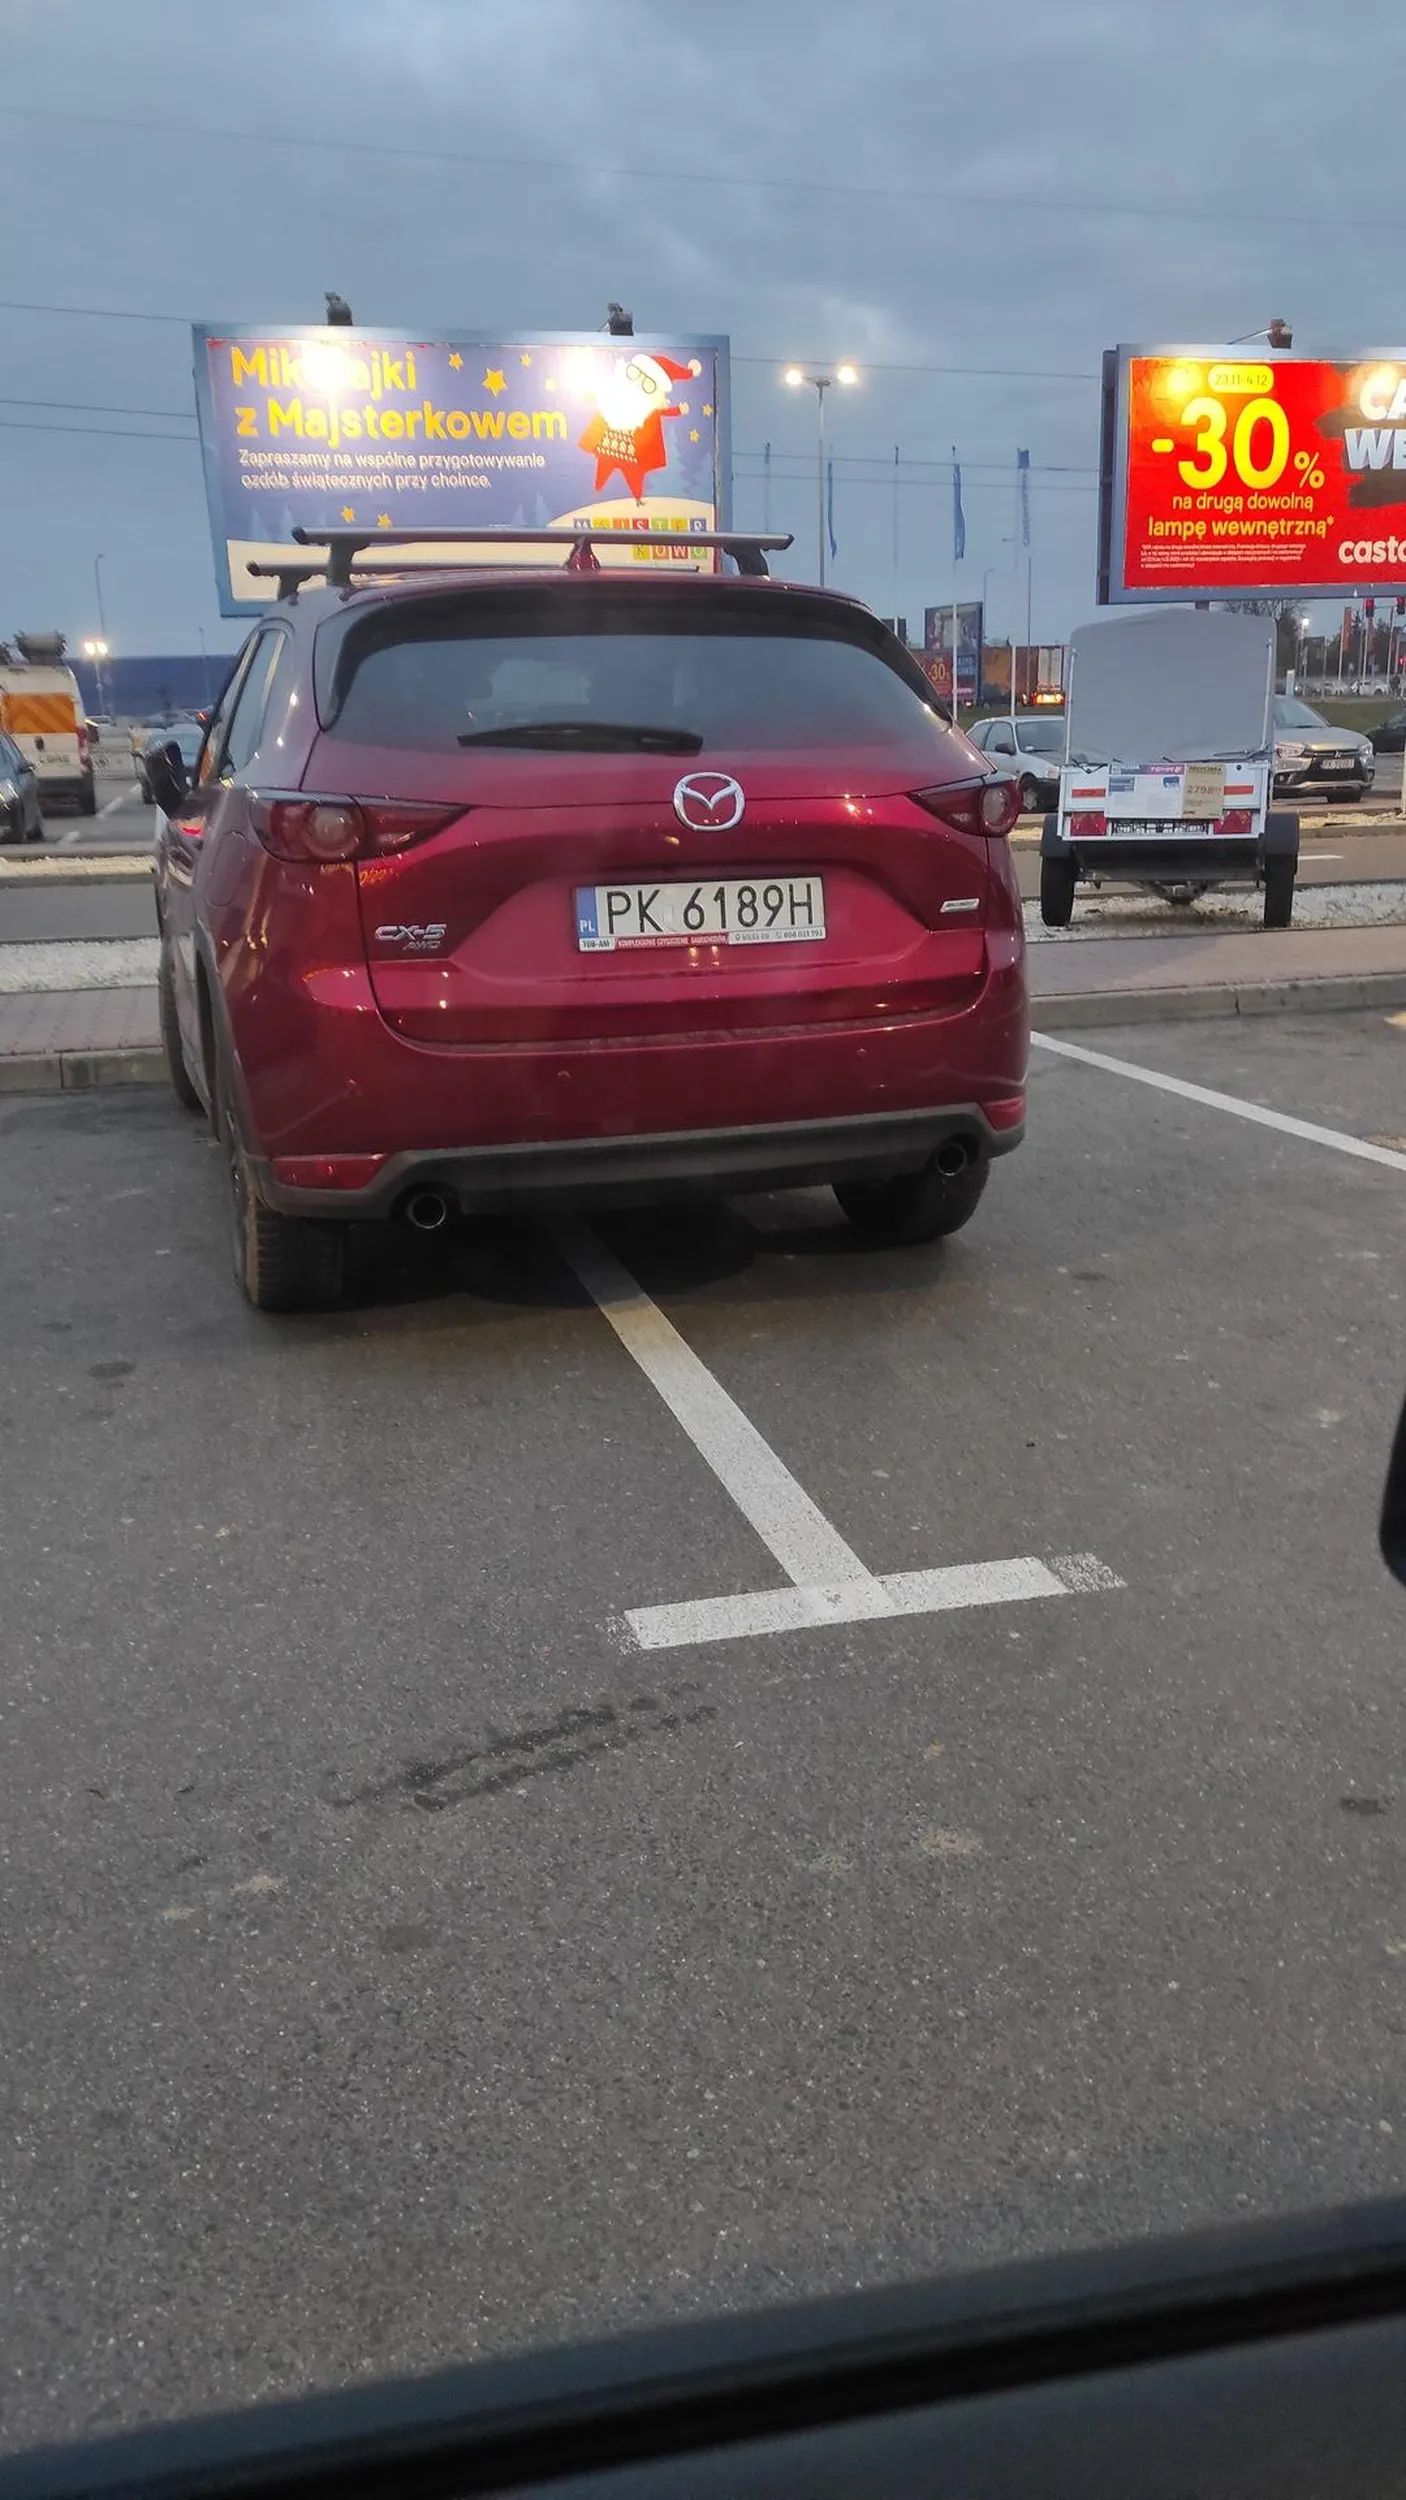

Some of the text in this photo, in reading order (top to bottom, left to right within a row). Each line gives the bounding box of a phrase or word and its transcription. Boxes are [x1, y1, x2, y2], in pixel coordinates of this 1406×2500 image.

[231, 346, 416, 401] Mikajki
[235, 397, 568, 448] z Majsterkowem
[239, 449, 546, 471] Zapraszamy na wspólne przygotowywanie
[241, 471, 290, 489] ozdób
[292, 471, 392, 492] świątecznych
[395, 474, 428, 494] przy
[1172, 492, 1314, 515] na drugą dowolną
[1148, 515, 1207, 541] lampę
[606, 882, 813, 934] PK 6189H
[375, 924, 447, 941] CX-5
[580, 920, 595, 933] PL
